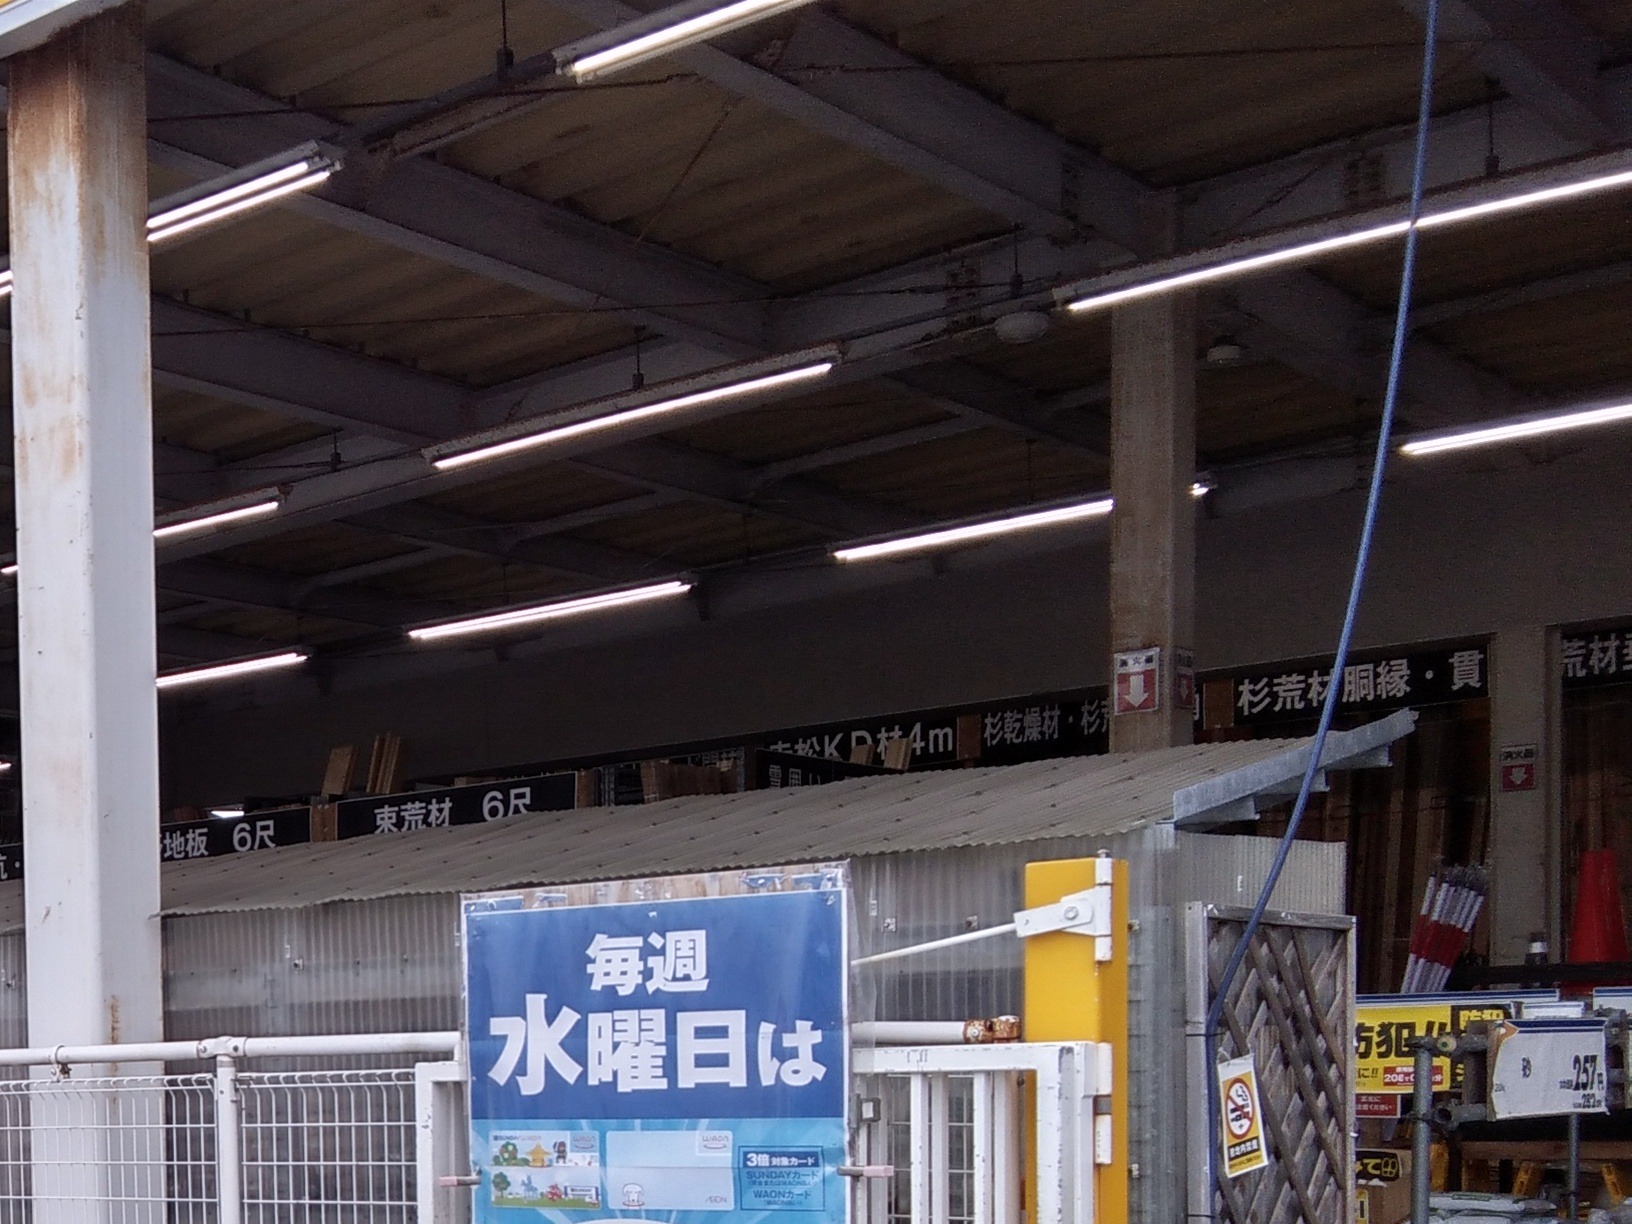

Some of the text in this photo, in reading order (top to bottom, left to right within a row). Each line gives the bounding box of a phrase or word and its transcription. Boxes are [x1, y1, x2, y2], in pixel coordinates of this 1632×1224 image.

[159, 820, 276, 860] 地板 6尺
[585, 929, 711, 996] 毎週
[488, 993, 828, 1096] 水曜日は
